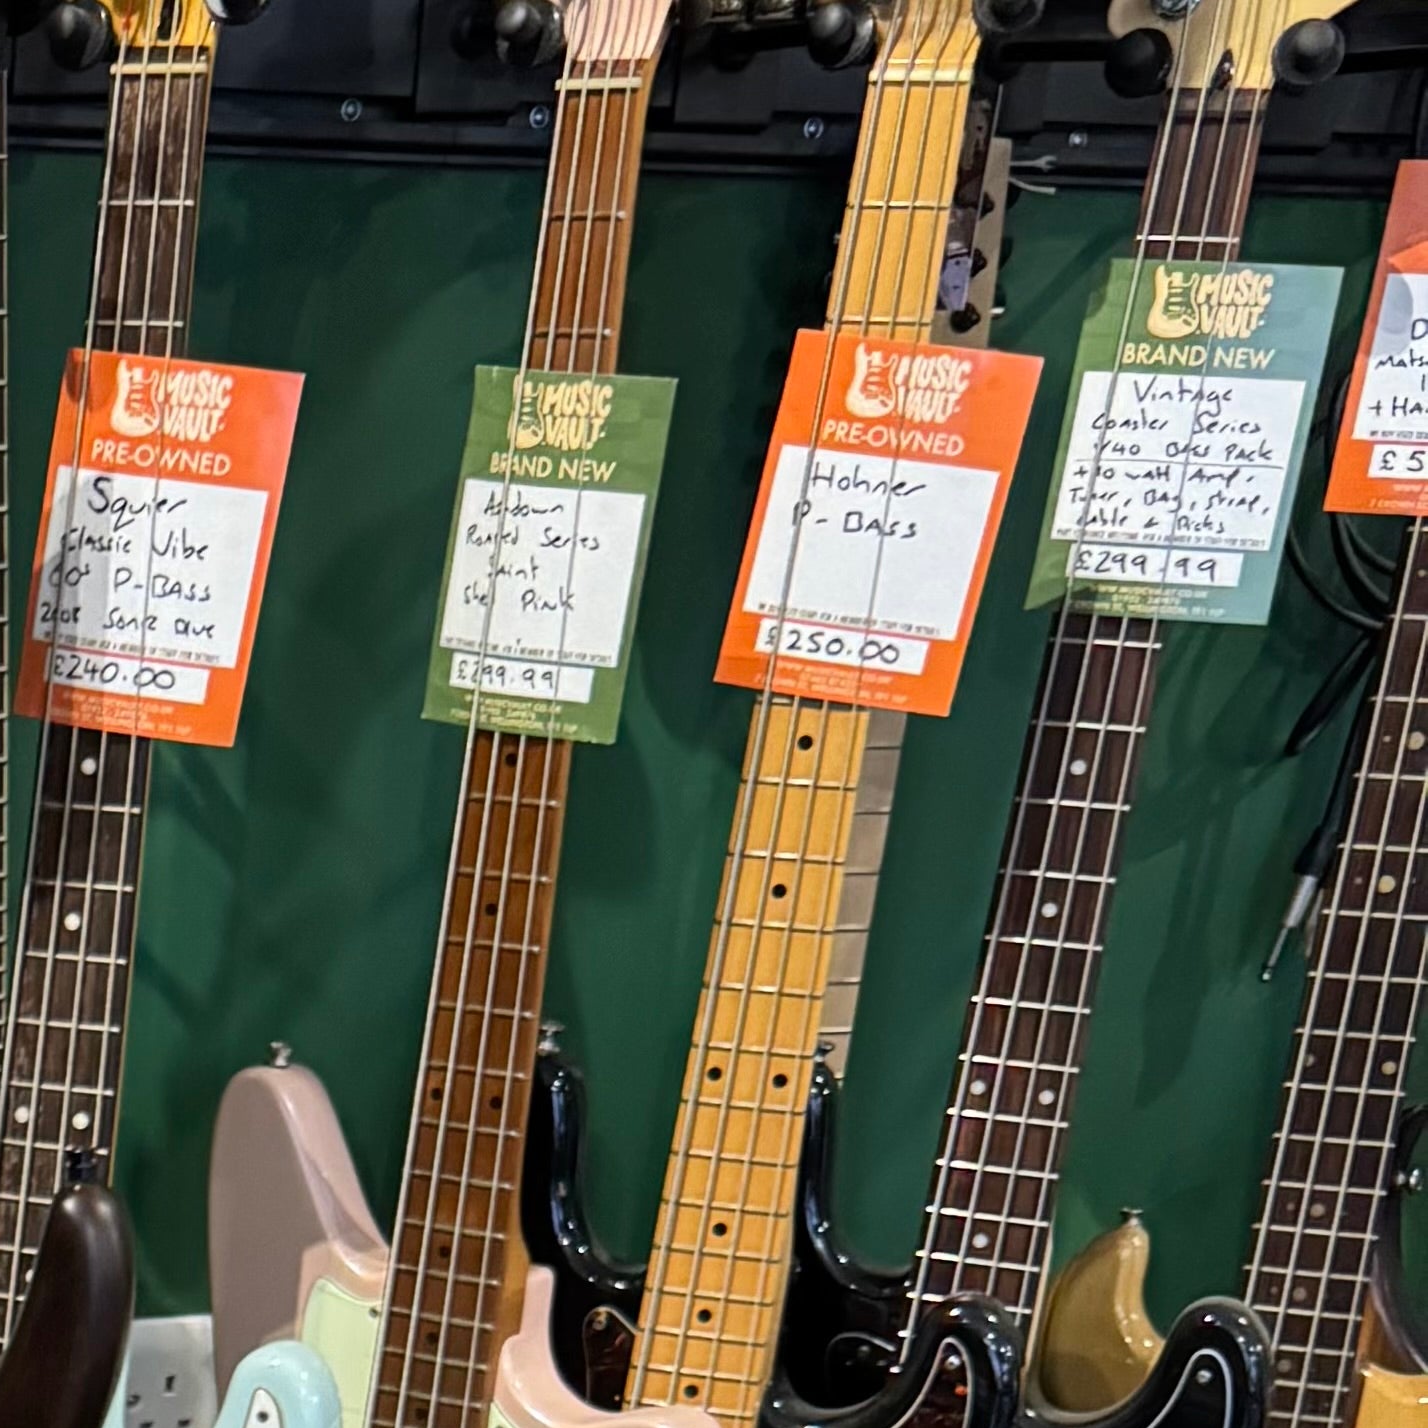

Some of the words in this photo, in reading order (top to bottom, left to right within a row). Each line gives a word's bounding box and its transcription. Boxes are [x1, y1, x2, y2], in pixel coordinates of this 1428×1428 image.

[1197, 269, 1275, 306] MUSIC
[1200, 303, 1263, 340] VAULT
[896, 353, 973, 391] MUSIC
[1122, 342, 1207, 367] BRAND
[1213, 347, 1275, 370] NEW
[160, 368, 233, 408] MUSIC
[543, 380, 614, 417] MUSIC
[899, 387, 957, 424] VAULT
[1134, 375, 1233, 417] Vintage
[163, 403, 222, 442] VAULT
[545, 414, 603, 451] VAULT
[822, 418, 966, 457] PRE-OWNED
[91, 439, 232, 476] PRE-OWNED
[558, 459, 617, 482] NEW
[811, 463, 927, 498] Hohner
[87, 477, 188, 531] Squier
[540, 526, 600, 551] Seres
[1075, 551, 1217, 582] £299.99
[103, 607, 158, 630] Sonc
[765, 626, 900, 664] £250.00
[54, 654, 175, 690] £240.00
